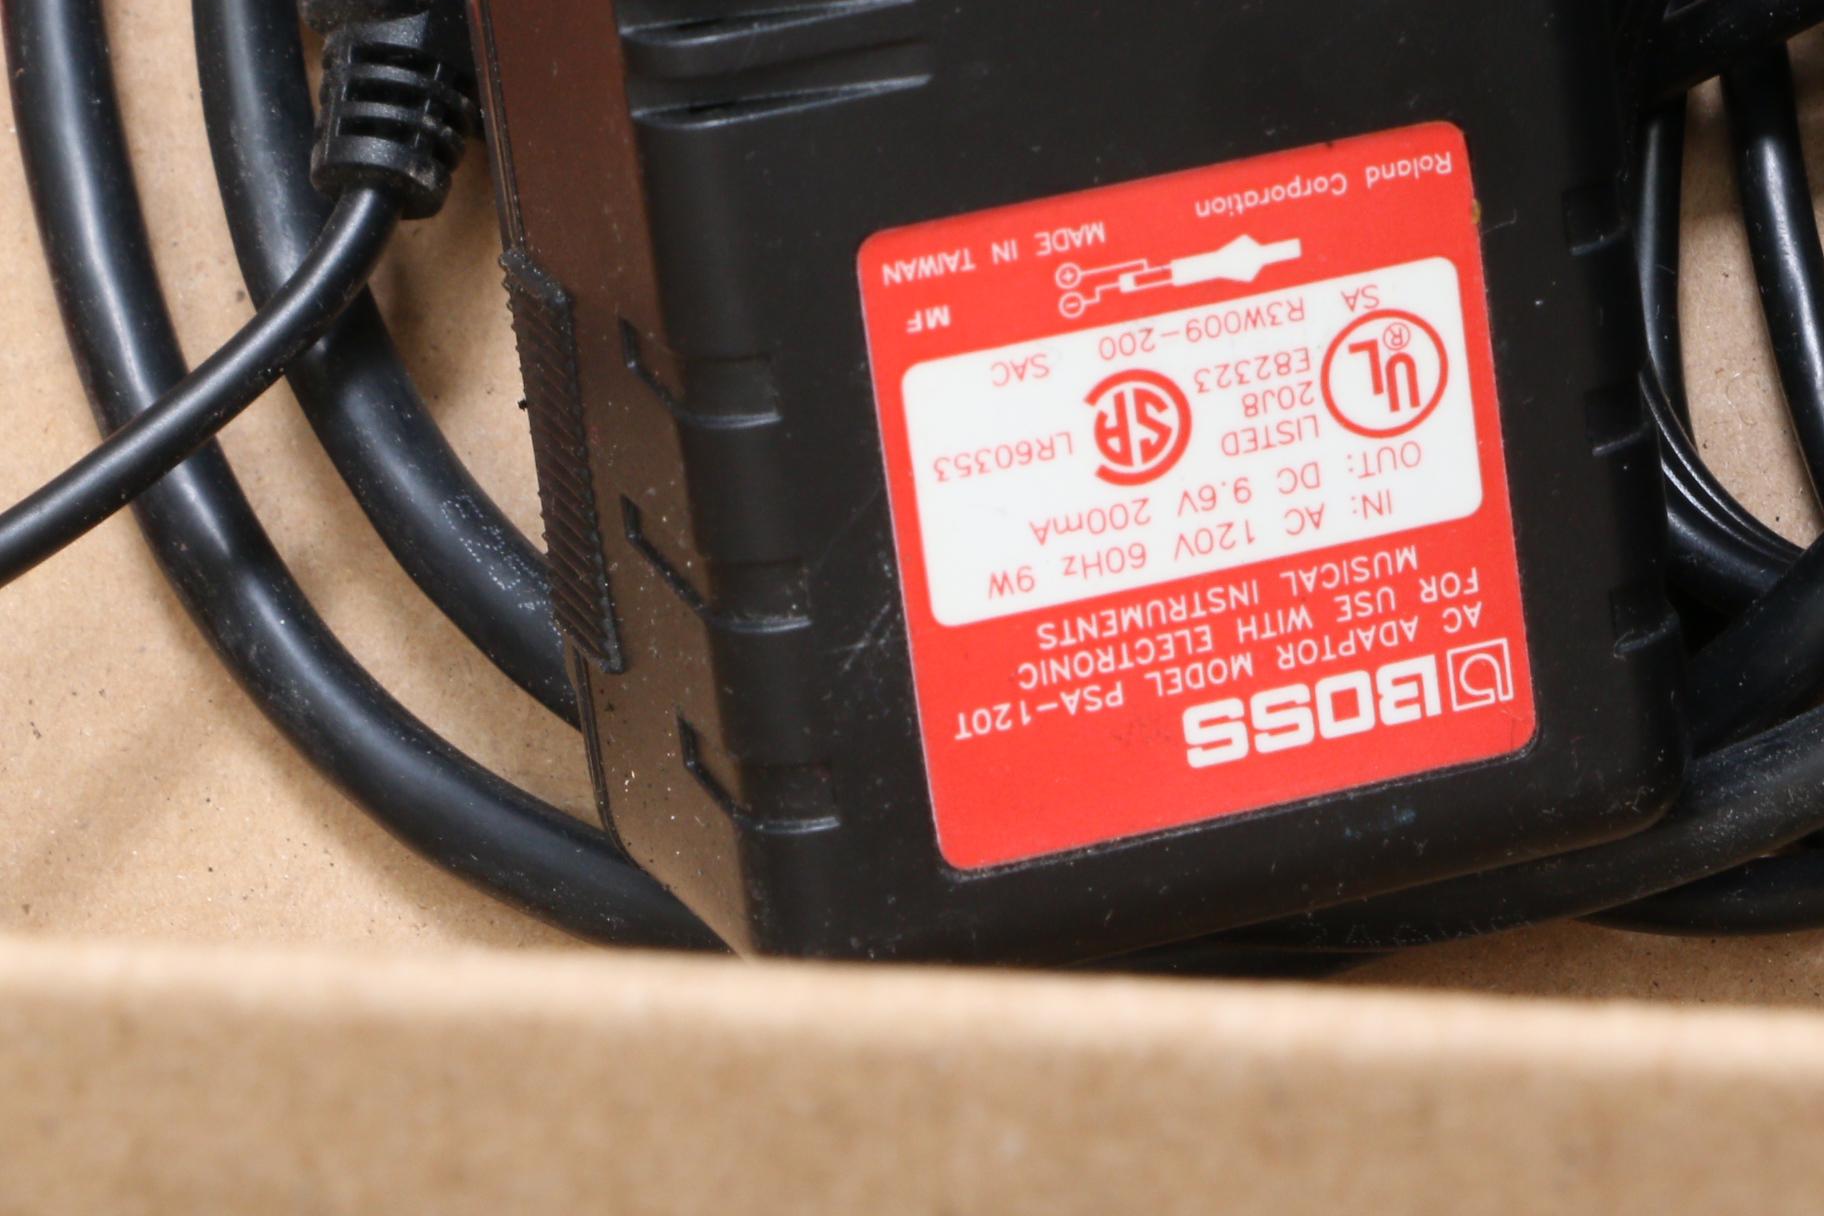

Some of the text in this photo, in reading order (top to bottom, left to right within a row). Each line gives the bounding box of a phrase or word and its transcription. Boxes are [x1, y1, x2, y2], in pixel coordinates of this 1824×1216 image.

[1193, 150, 1453, 218] Roland Corporation
[881, 221, 1106, 285] MADE IN TAIWAN
[906, 304, 951, 333] MF
[991, 283, 1381, 387] SA R3W009-200 SAC
[1192, 346, 1311, 394] E82323
[1240, 378, 1315, 418] 20J8
[932, 430, 1073, 483] LR60353
[1219, 412, 1320, 457] LISTED
[1028, 439, 1422, 546] OUT: DC 9.6V 200mA
[988, 488, 1392, 597] IN: AC 120V 60Hz 9W
[1017, 566, 1479, 690] FOR USE WITH ELECTRONIC
[1035, 544, 1418, 650] MUSICAL INSTRUMENTS
[953, 600, 1482, 741] AC ADAPTOR MODEL PSA-120T
[1181, 653, 1442, 769] BOSS
